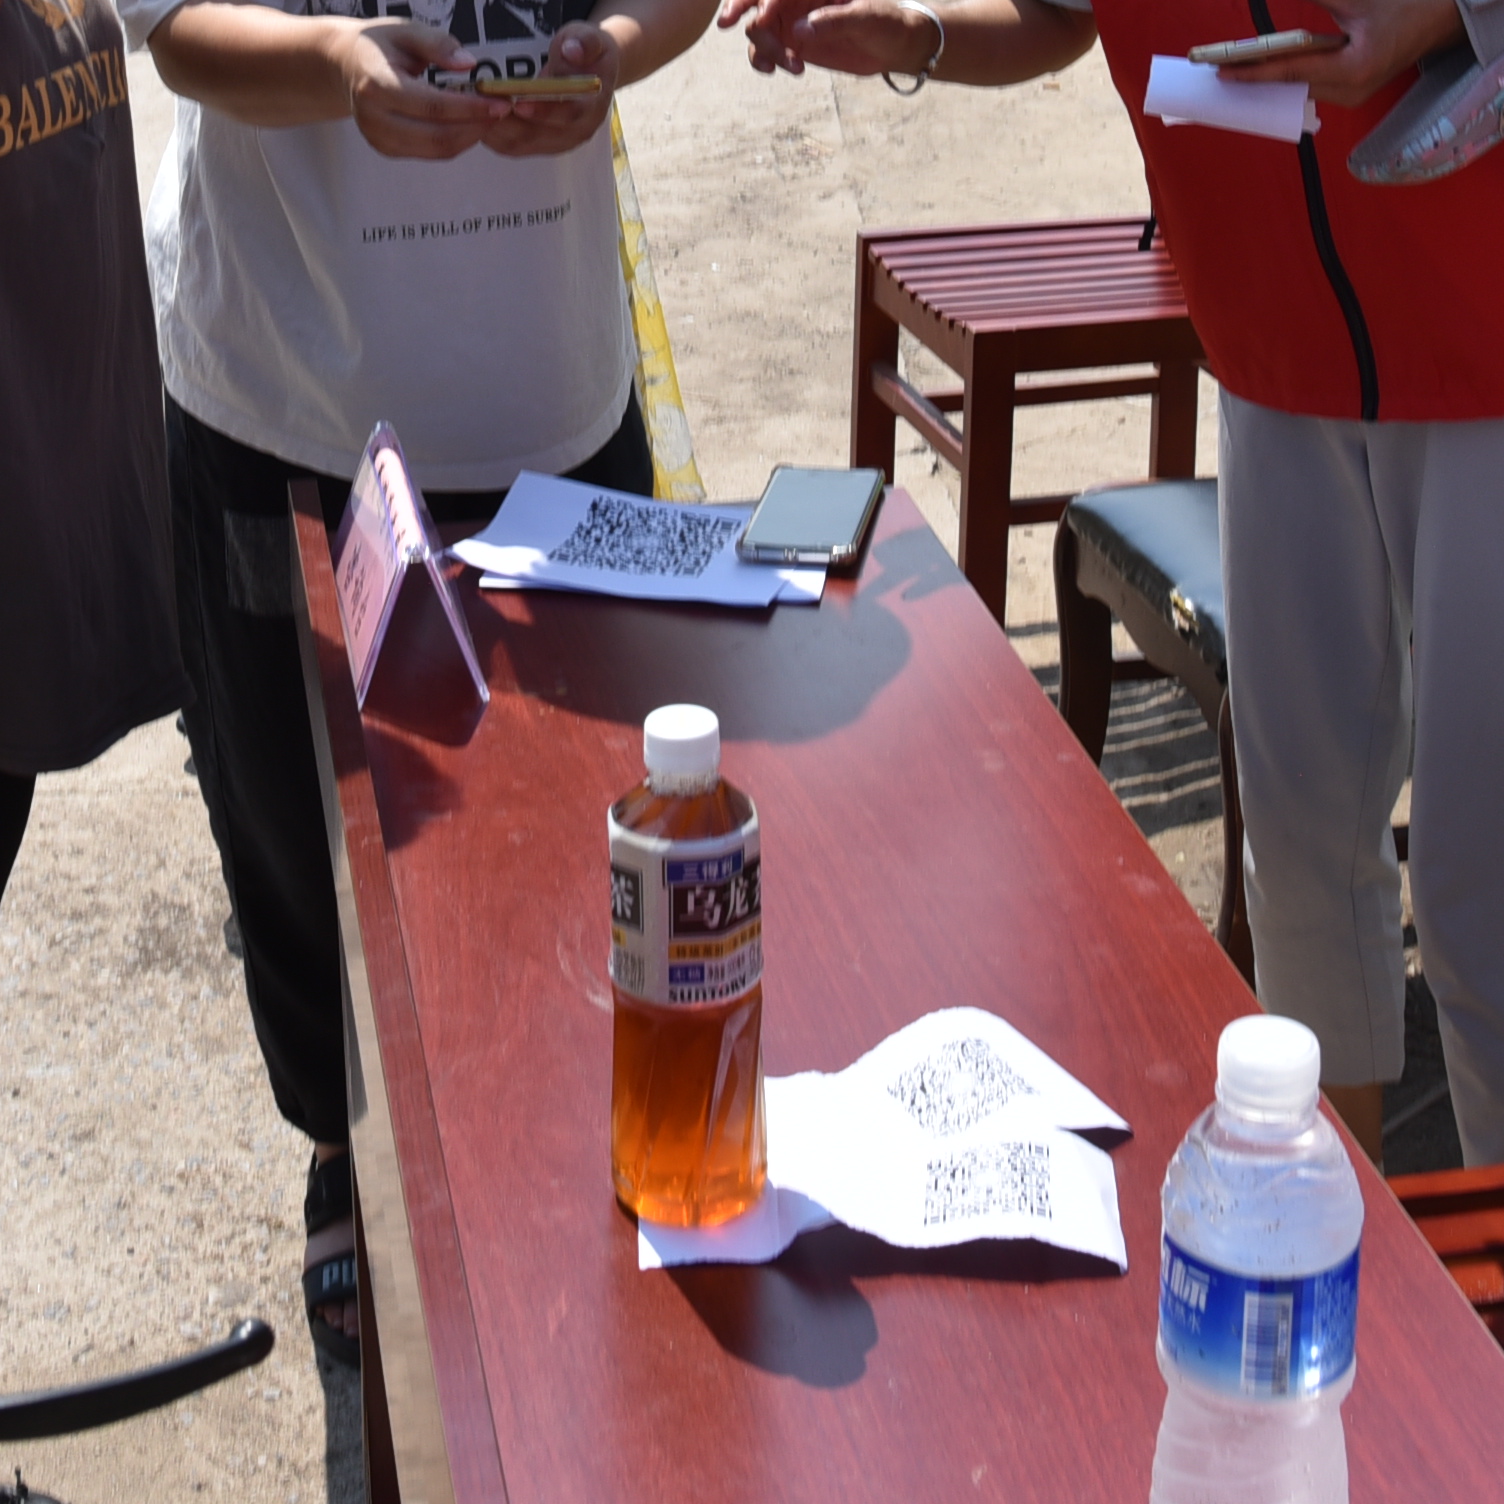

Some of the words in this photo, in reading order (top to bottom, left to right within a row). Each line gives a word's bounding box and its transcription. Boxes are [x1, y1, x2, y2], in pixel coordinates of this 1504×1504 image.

[362, 225, 397, 243] LIFE
[401, 224, 416, 240] IS
[420, 221, 460, 239] FULL
[462, 217, 483, 234] OF
[487, 212, 523, 231] FINE
